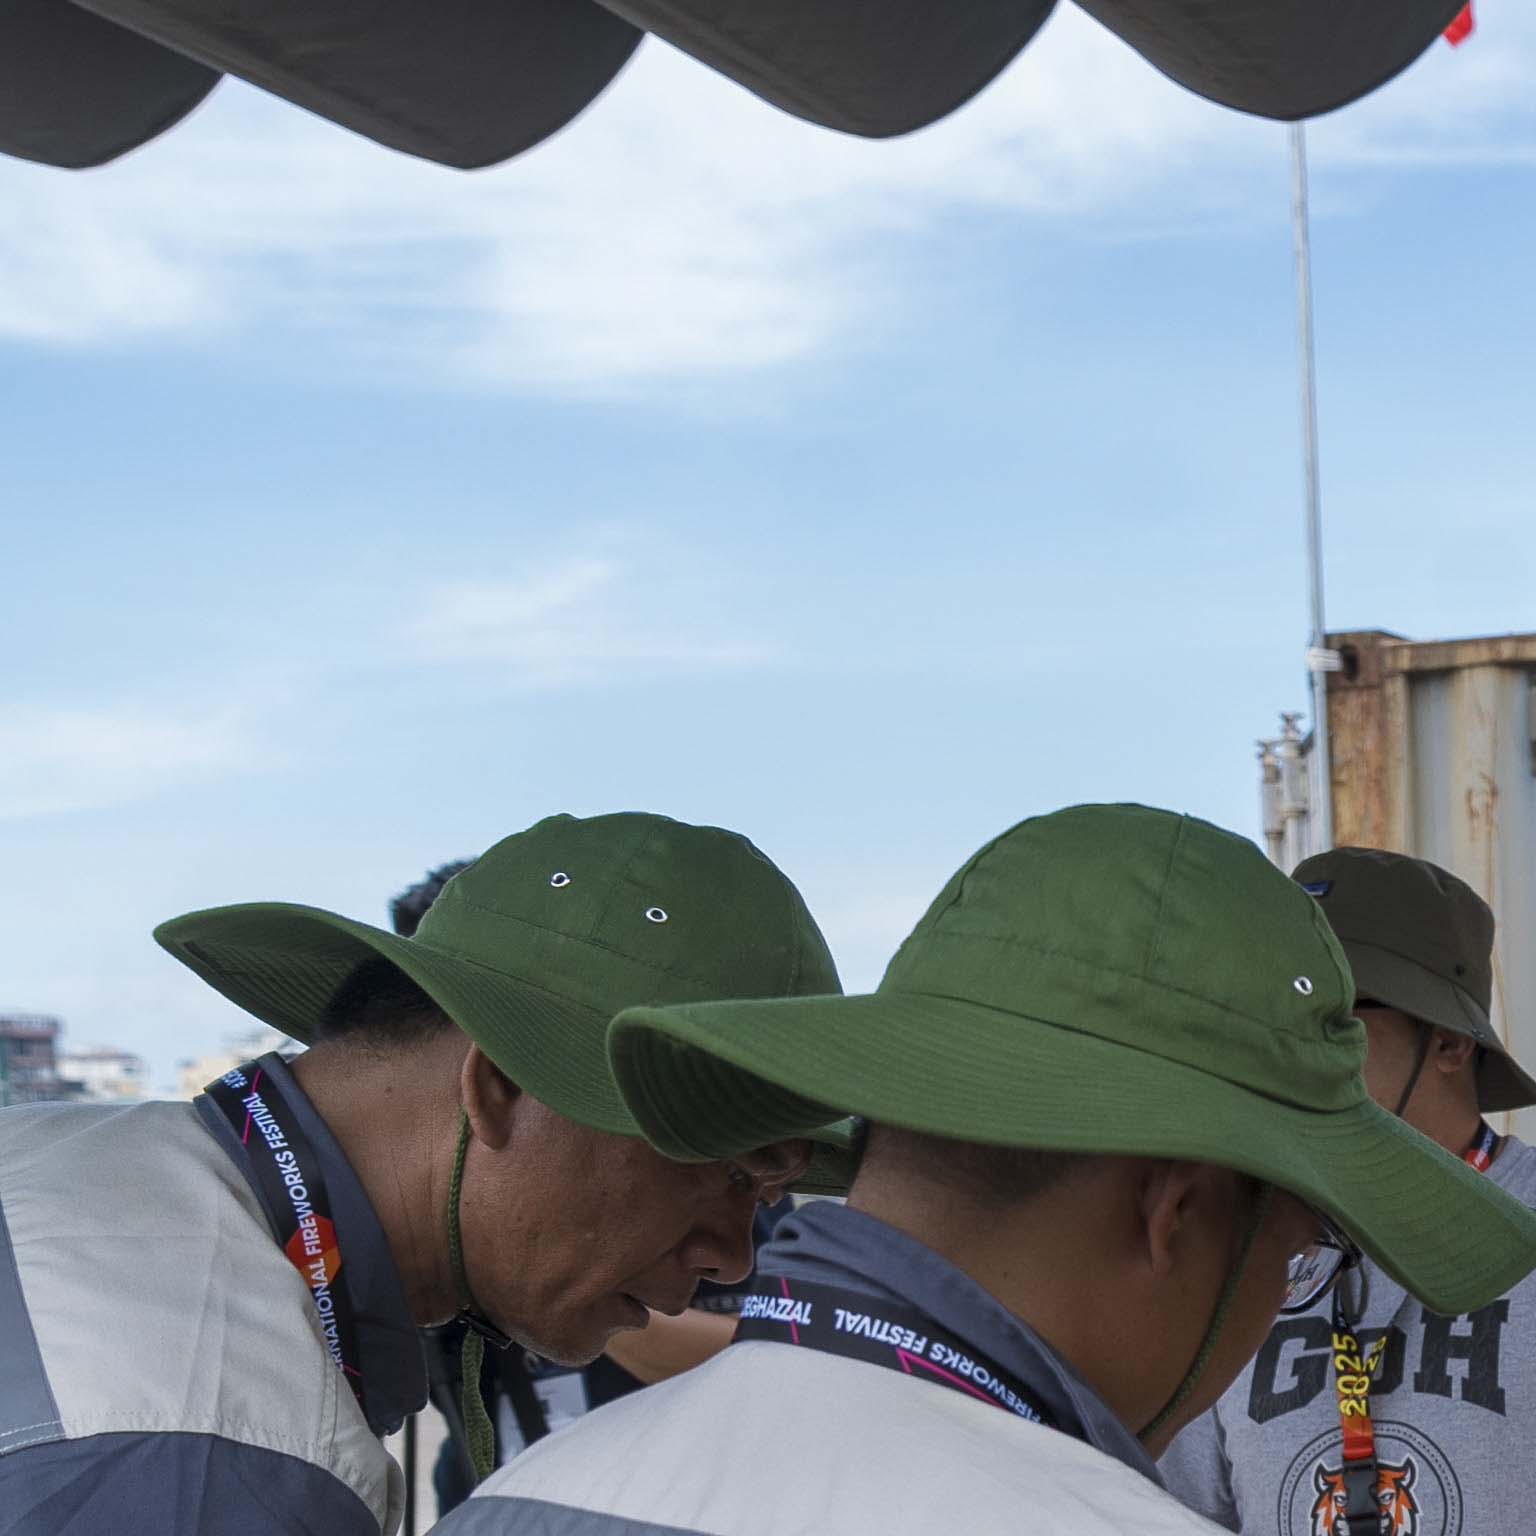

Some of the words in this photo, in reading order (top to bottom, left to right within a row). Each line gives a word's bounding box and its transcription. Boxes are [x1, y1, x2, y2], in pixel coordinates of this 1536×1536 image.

[242, 1092, 288, 1149] FESTIVAL
[274, 1150, 323, 1257] FIREWORKS
[309, 1258, 344, 1372] RNATIONAL
[741, 1295, 812, 1326] EGHAZZAL
[833, 1307, 927, 1358] FESTIVAL
